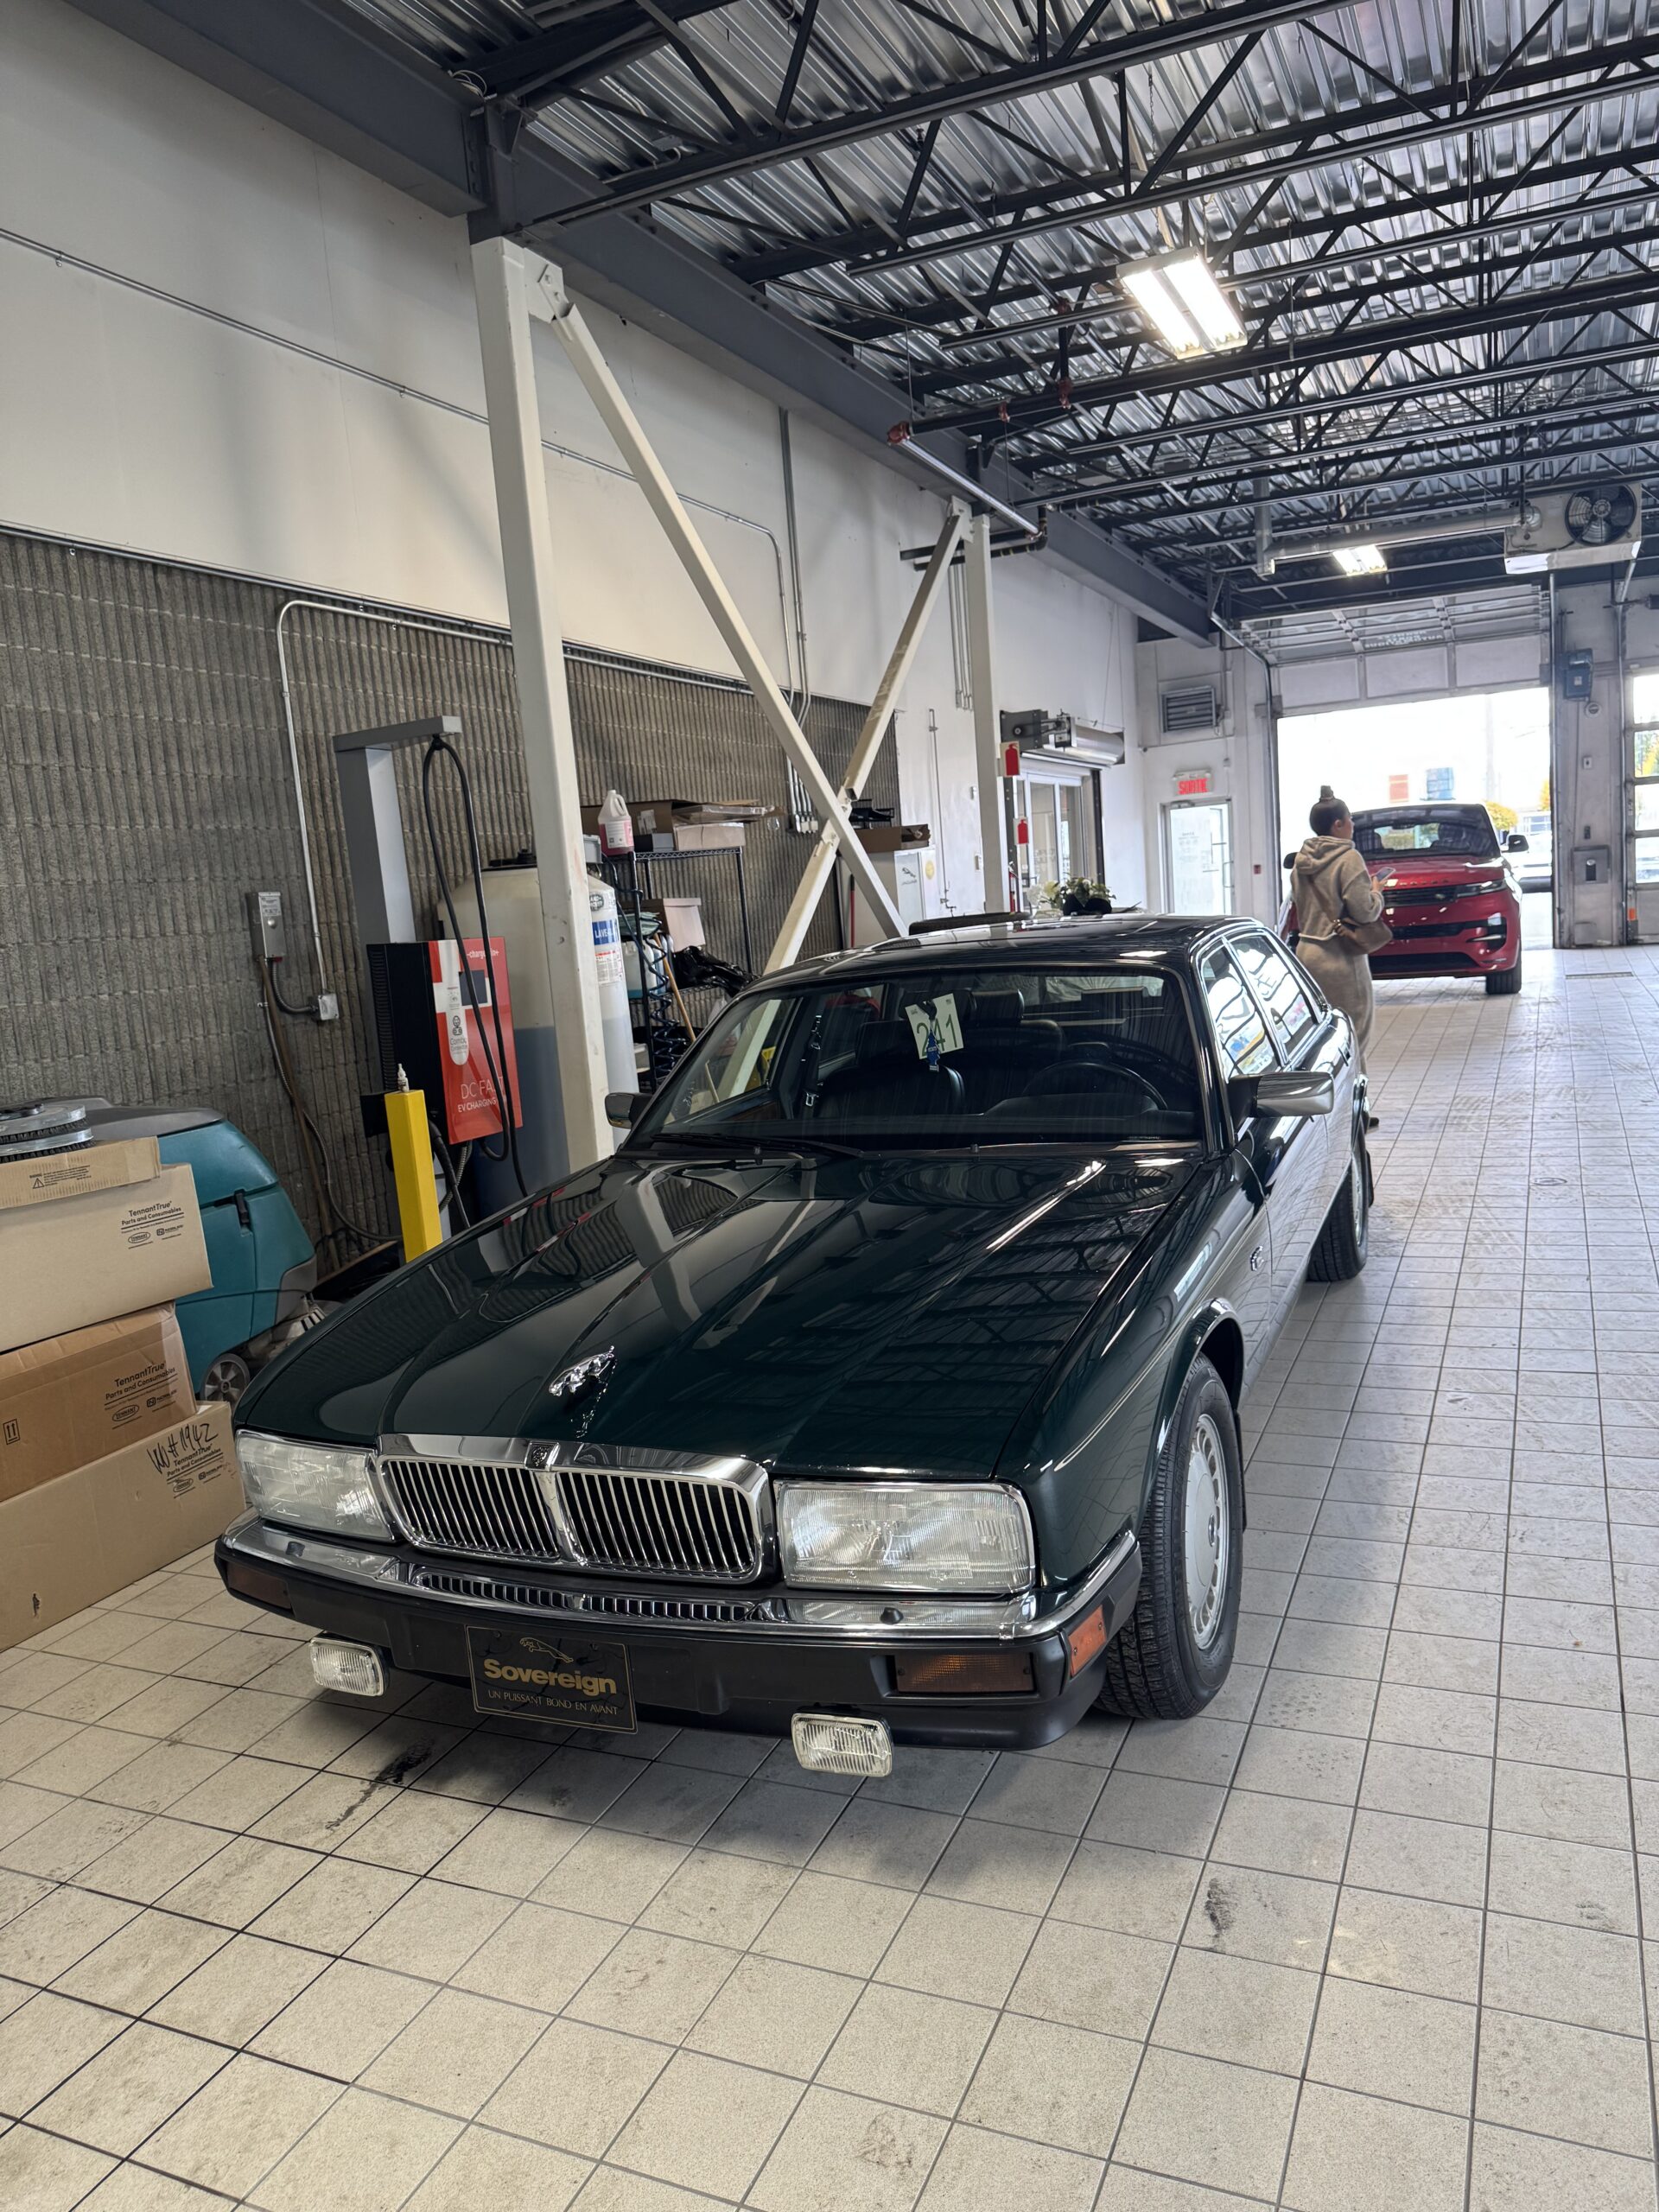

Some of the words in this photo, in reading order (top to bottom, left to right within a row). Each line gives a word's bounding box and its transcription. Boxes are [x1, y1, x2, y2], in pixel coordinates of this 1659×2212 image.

[916, 1014, 957, 1057] 241
[461, 1082, 477, 1099] DC
[479, 1076, 504, 1096] FAT
[457, 1103, 466, 1113] EV
[467, 1096, 497, 1111] CHARGING
[147, 1207, 181, 1219] Consumables
[105, 1389, 123, 1400] Parts
[124, 1382, 137, 1393] and
[137, 1368, 175, 1388] Consumables
[167, 1466, 180, 1477] Parts
[484, 1658, 617, 1696] Sovereign
[487, 1689, 501, 1699] UN
[504, 1693, 543, 1706] PUISSANT
[546, 1698, 572, 1708] BOND
[575, 1701, 587, 1711] EN
[589, 1705, 618, 1715] AVANT
